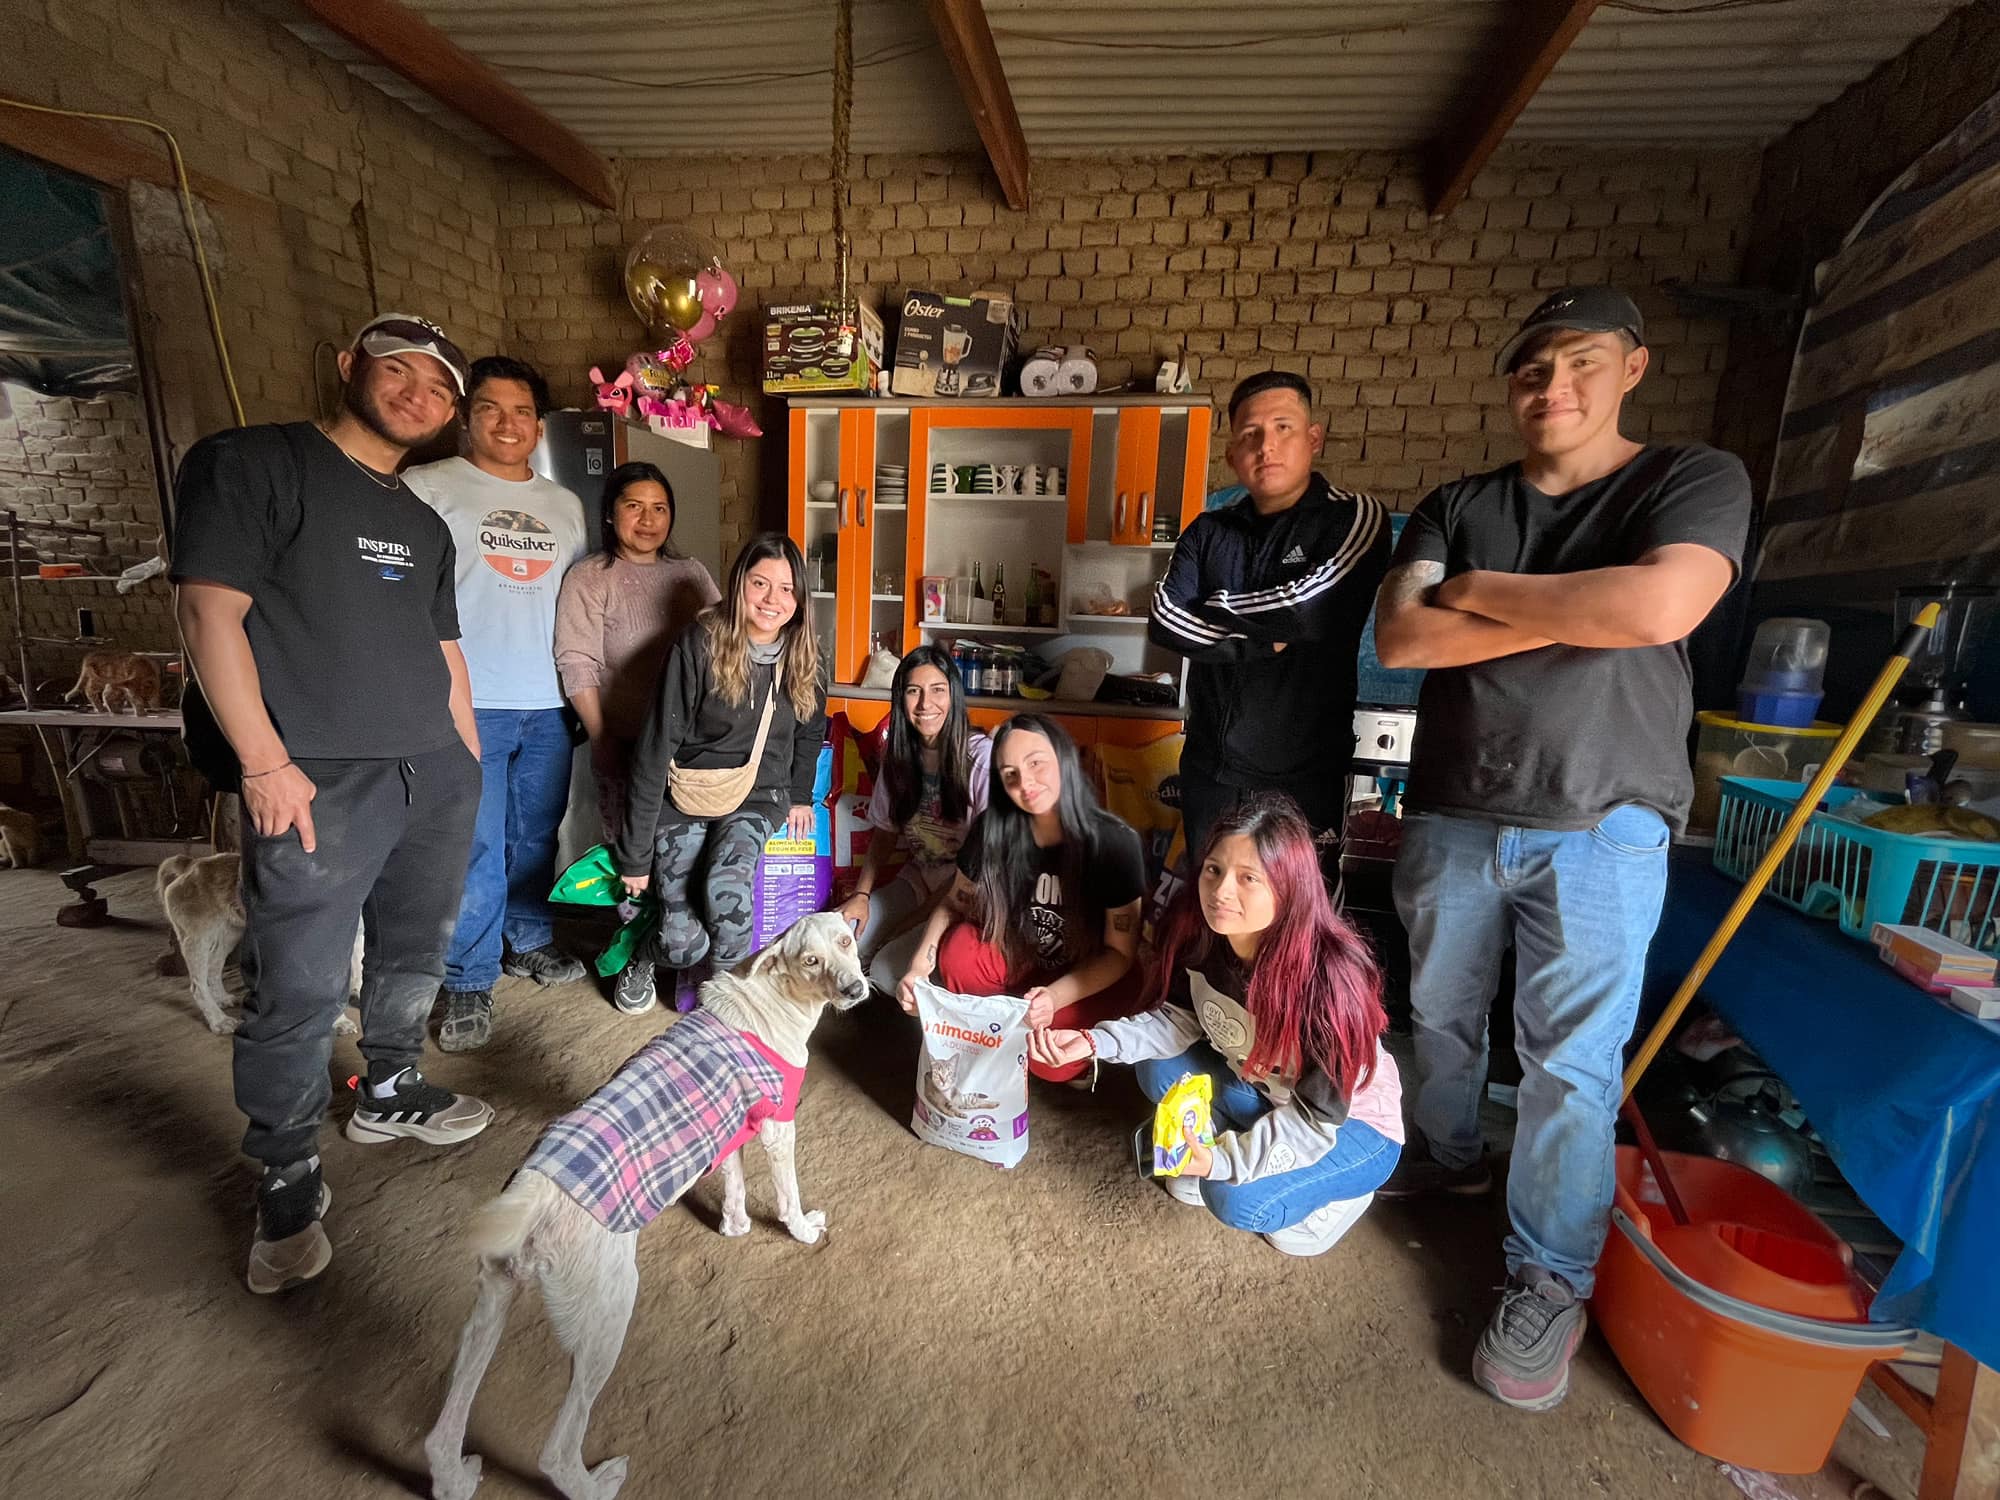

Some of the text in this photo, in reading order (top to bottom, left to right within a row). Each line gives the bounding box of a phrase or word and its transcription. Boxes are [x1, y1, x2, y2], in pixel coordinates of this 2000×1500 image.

[770, 305, 812, 315] BRIKENIA
[904, 299, 945, 318] Oster
[480, 531, 555, 551] Quiksilver
